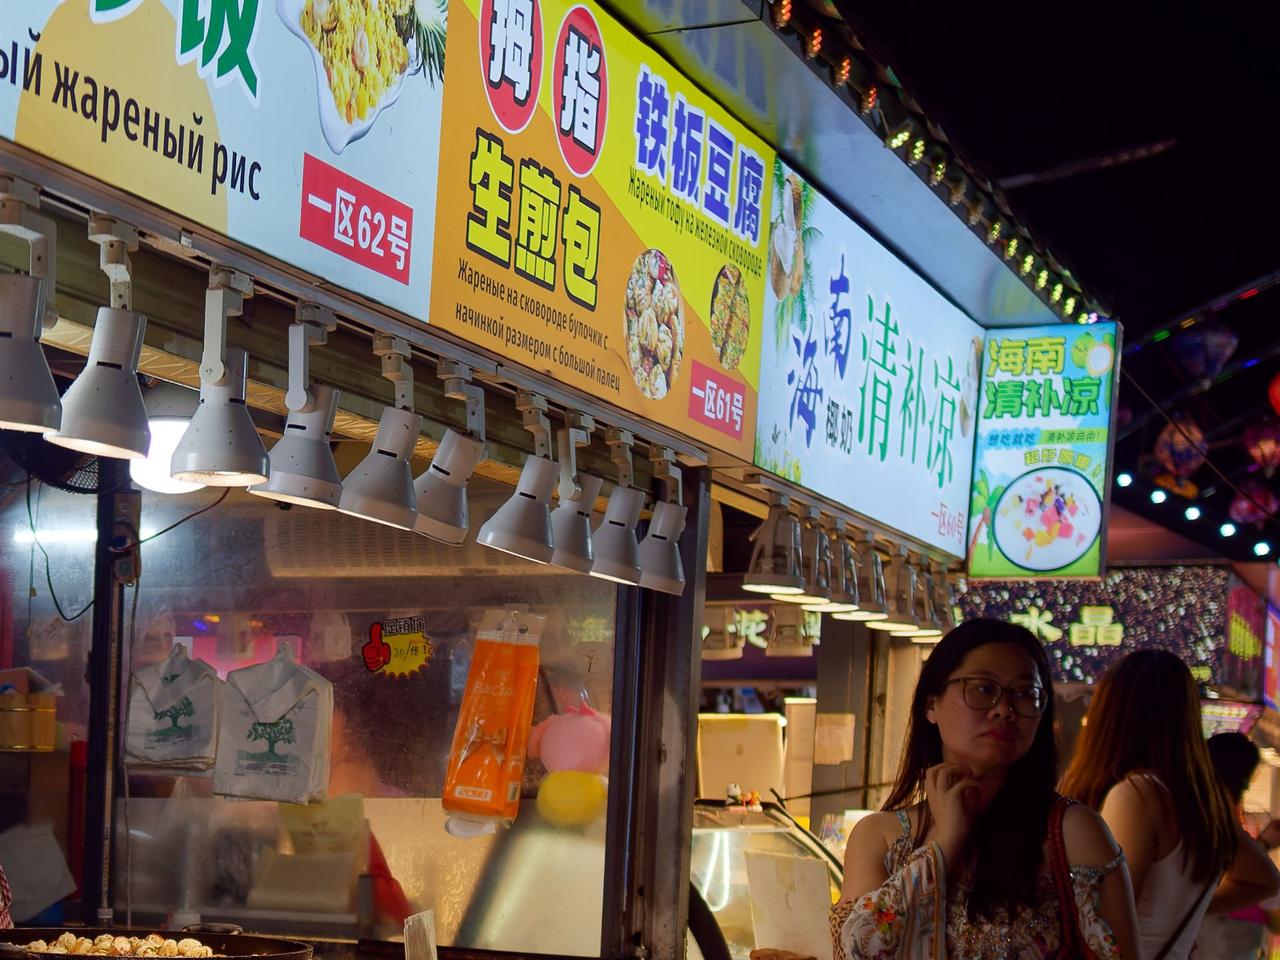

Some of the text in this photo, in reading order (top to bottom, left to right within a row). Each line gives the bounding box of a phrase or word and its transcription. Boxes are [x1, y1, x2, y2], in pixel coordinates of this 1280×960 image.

[489, 0, 601, 153] 拇指
[52, 60, 204, 174] жареный
[211, 141, 262, 200] рис
[636, 69, 764, 243] 铁板豆腐
[308, 187, 409, 271] 一区62号
[467, 128, 601, 311] 生煎包
[666, 197, 685, 234] тофу
[685, 210, 694, 234] на
[729, 240, 763, 281] сковороде
[455, 302, 504, 340] начинкой
[505, 326, 552, 360] размером
[552, 346, 558, 363] с
[559, 344, 596, 378] большой
[457, 257, 609, 351] Жареные на сковороде булочки с
[858, 294, 961, 489] 清补凉
[983, 377, 1102, 420] 清补凉
[985, 336, 1066, 377] 海南
[692, 379, 743, 431] 一区61号
[825, 397, 853, 454] 椰奶
